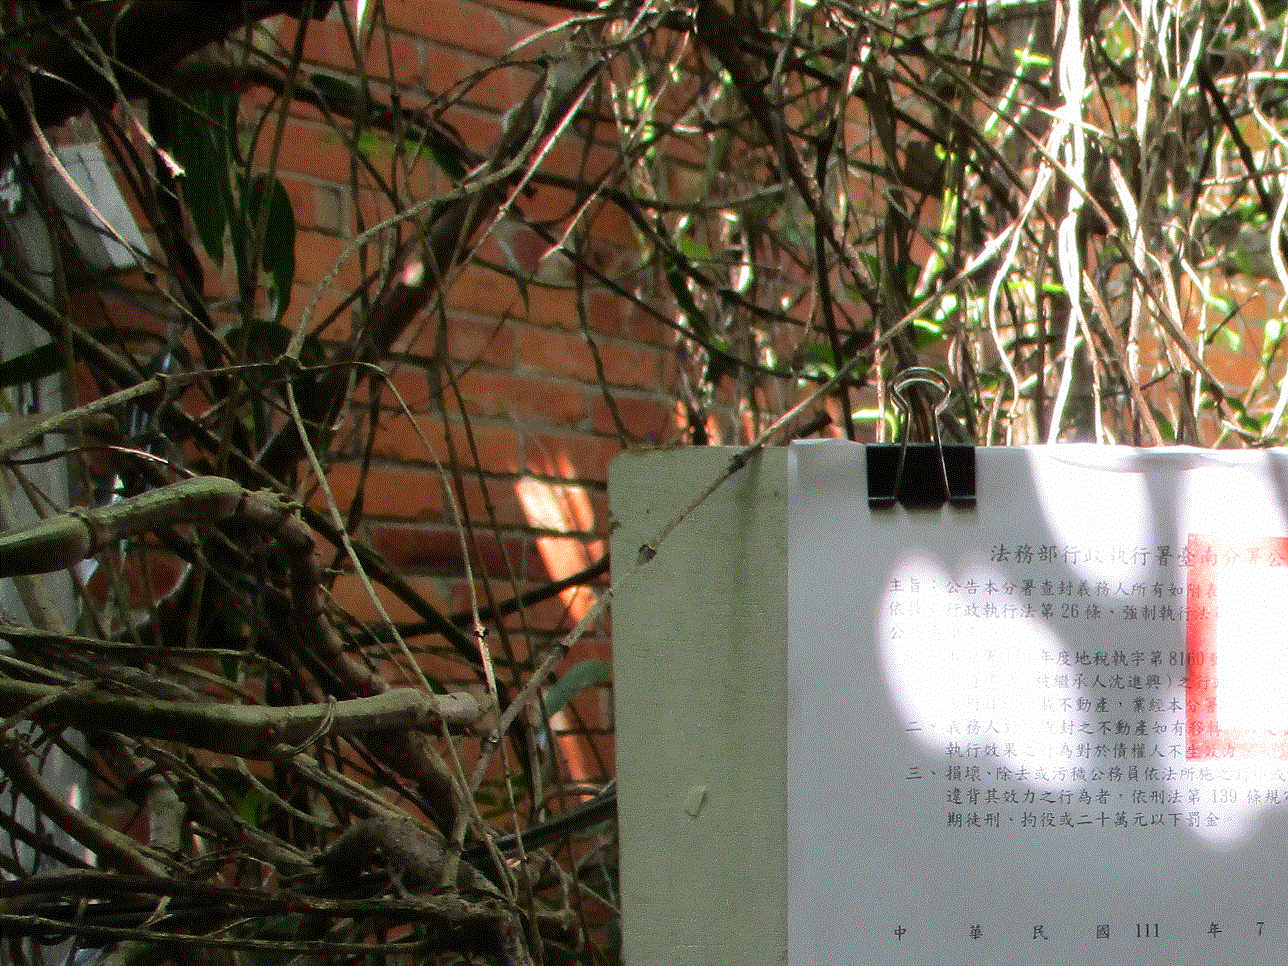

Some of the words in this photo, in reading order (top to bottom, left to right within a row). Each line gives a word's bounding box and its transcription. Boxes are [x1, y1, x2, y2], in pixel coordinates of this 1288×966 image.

[893, 925, 907, 942] 中
[969, 925, 984, 942] 華
[1033, 925, 1048, 941] 民
[1096, 924, 1111, 940] 國
[1135, 923, 1160, 939] 111
[1207, 922, 1223, 938] 年
[1256, 922, 1264, 937] 7
